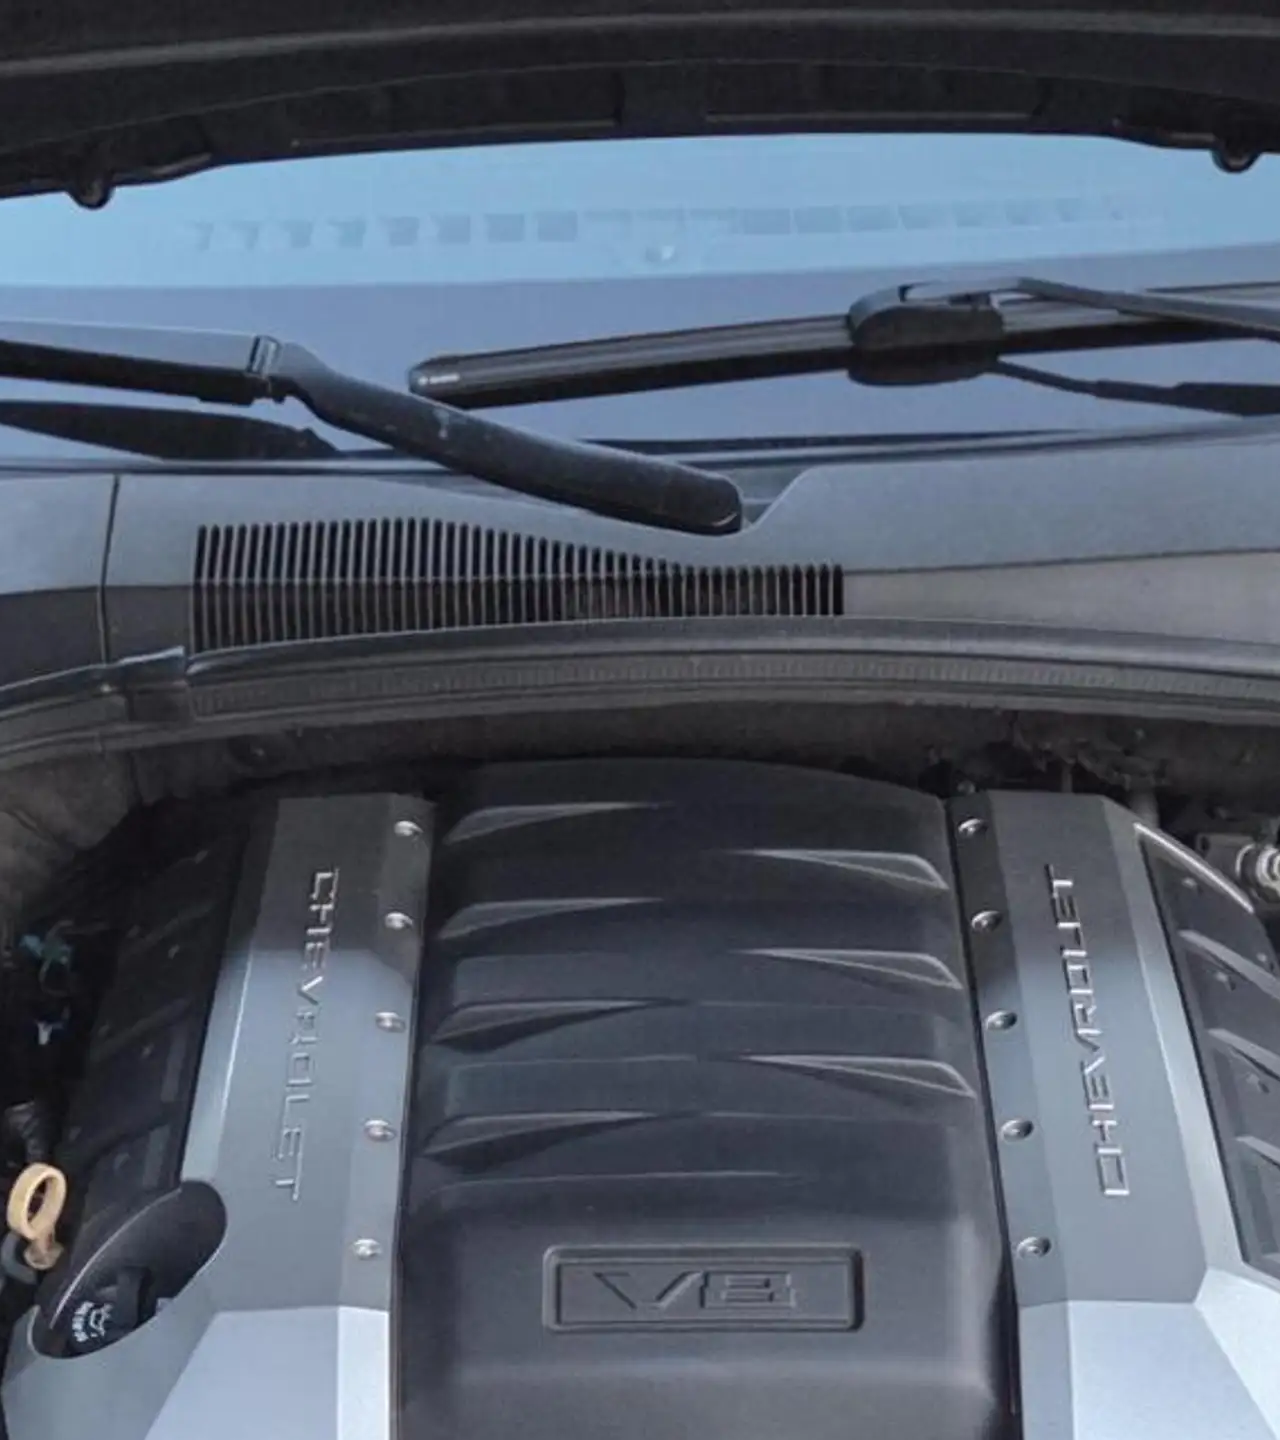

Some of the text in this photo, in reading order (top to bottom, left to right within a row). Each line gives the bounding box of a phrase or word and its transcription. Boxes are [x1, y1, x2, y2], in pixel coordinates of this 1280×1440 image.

[274, 867, 340, 1201] CHEVROLET
[1044, 863, 1131, 1196] CHEVROLET
[593, 1269, 796, 1310] V8
